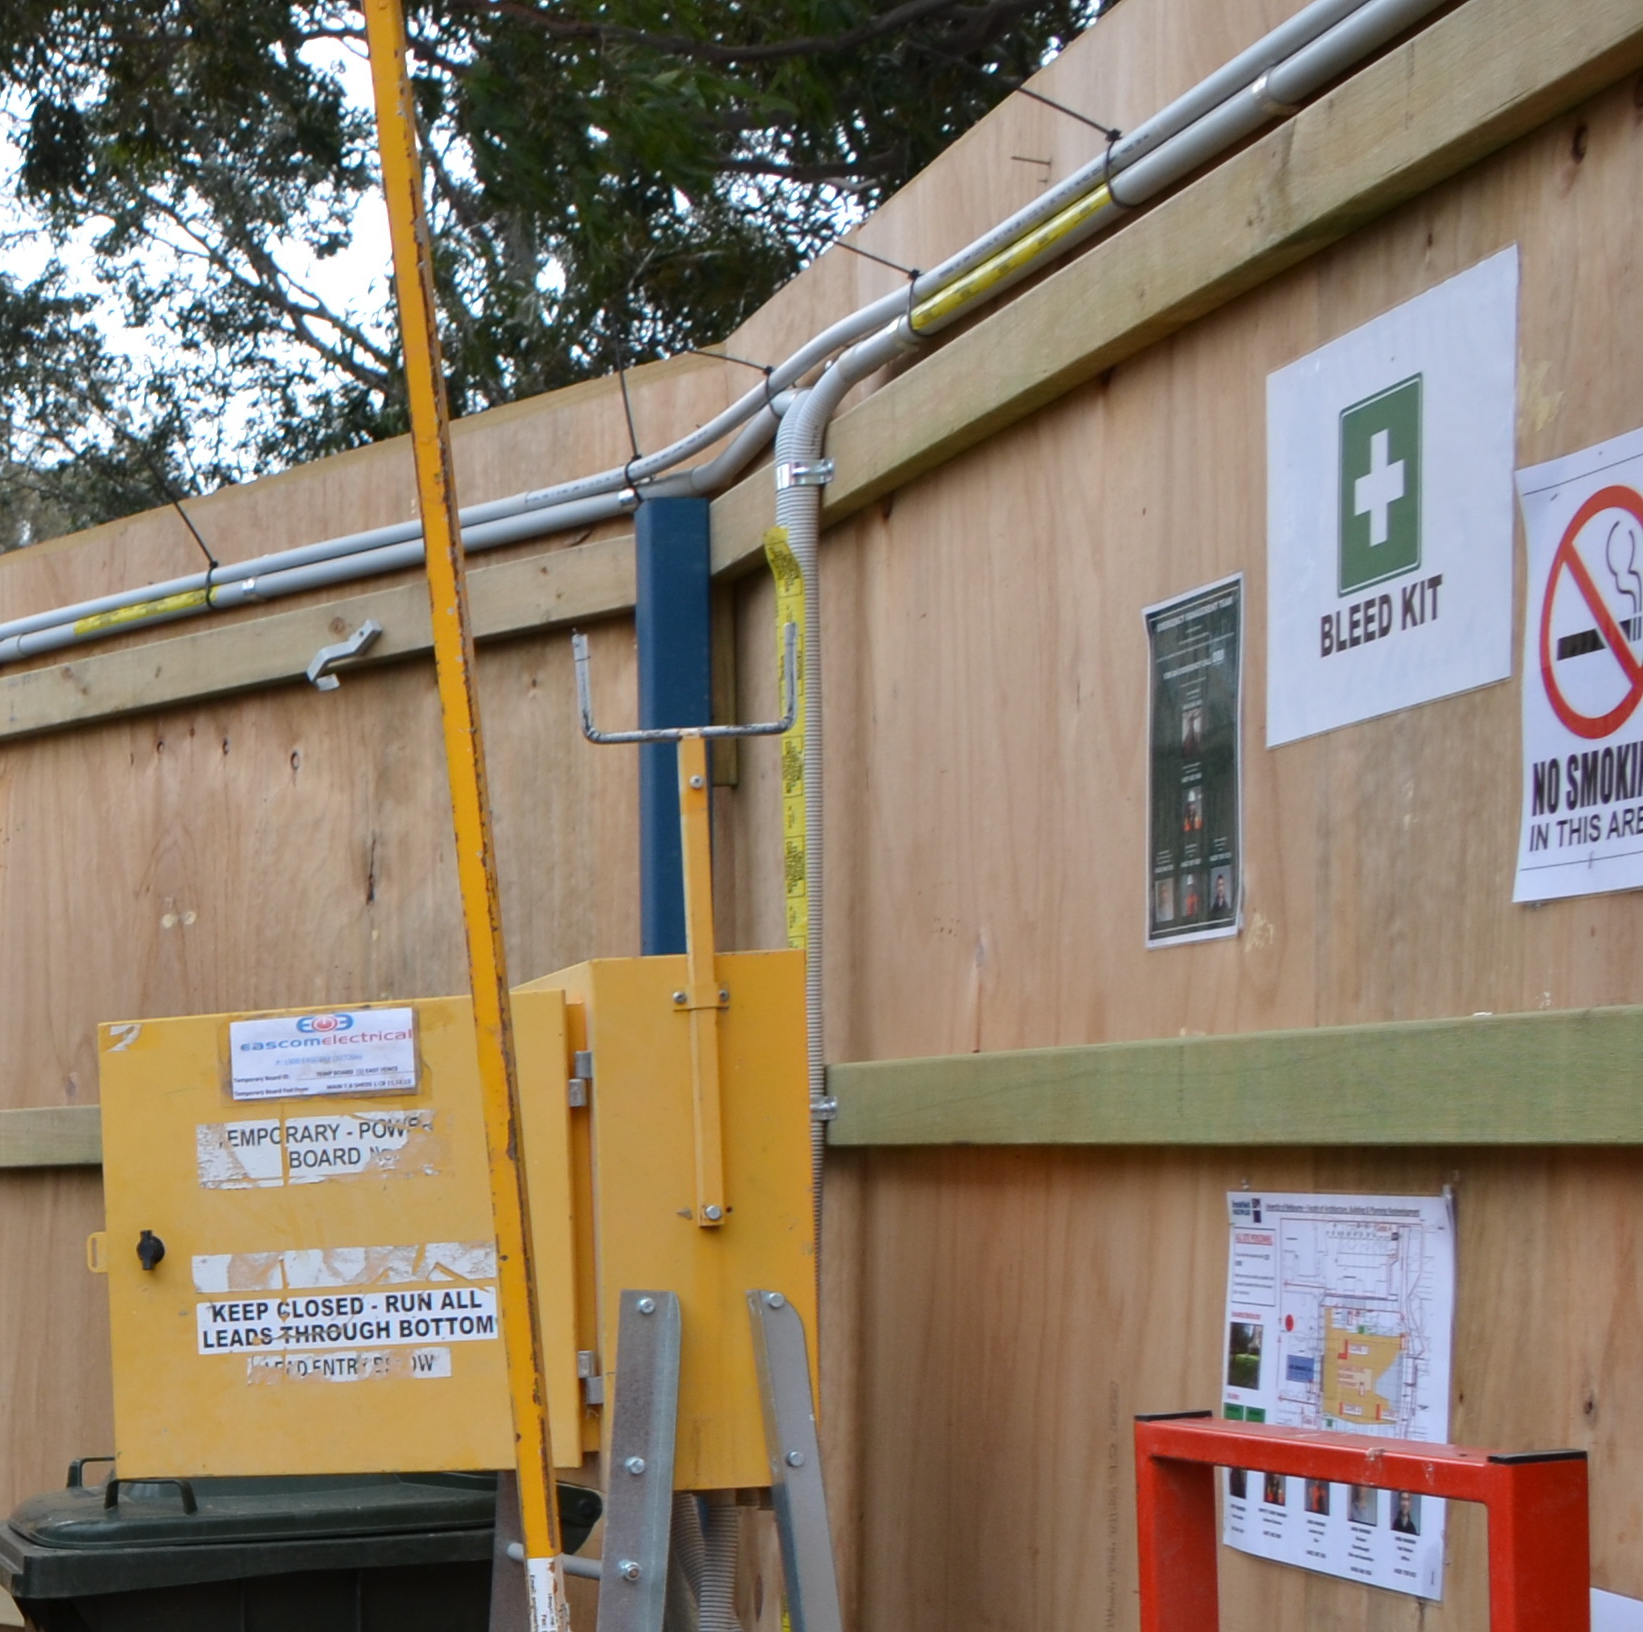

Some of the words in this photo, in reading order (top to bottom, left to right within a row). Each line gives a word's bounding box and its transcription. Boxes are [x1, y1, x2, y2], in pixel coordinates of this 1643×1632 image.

[1320, 593, 1393, 659] BLEED
[1401, 573, 1443, 631] KIT
[1531, 758, 1560, 817] NO
[1529, 822, 1550, 852] IN
[1556, 813, 1602, 848] THIS
[288, 1147, 361, 1169] BOARD
[211, 1302, 269, 1323] KEEP
[277, 1296, 364, 1319] CLOSED
[385, 1292, 433, 1313] RUN
[440, 1290, 483, 1311] ALL
[203, 1327, 273, 1349] LEADS
[283, 1318, 391, 1346] THROUGH
[399, 1314, 494, 1338] BOTTOM
